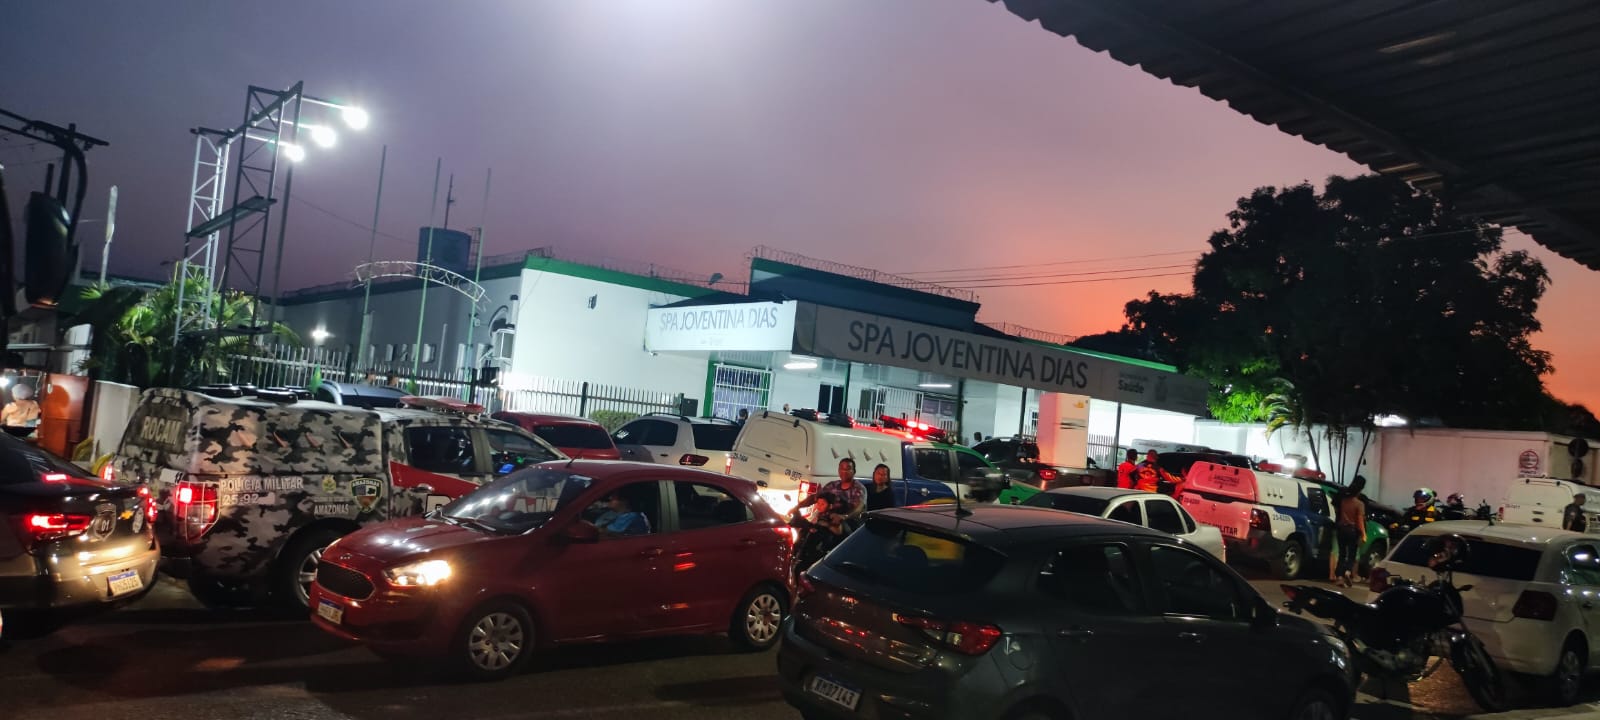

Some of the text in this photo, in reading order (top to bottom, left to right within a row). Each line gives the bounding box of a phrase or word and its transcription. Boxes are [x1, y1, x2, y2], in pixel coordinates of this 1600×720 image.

[659, 306, 778, 331] SPA JOVENTINA DIAS
[848, 320, 1088, 389] SPA JOVENTINA DIAS
[140, 415, 182, 445] ROCAM
[264, 477, 304, 490] MILITAR
[314, 503, 350, 515] AMAZONAS
